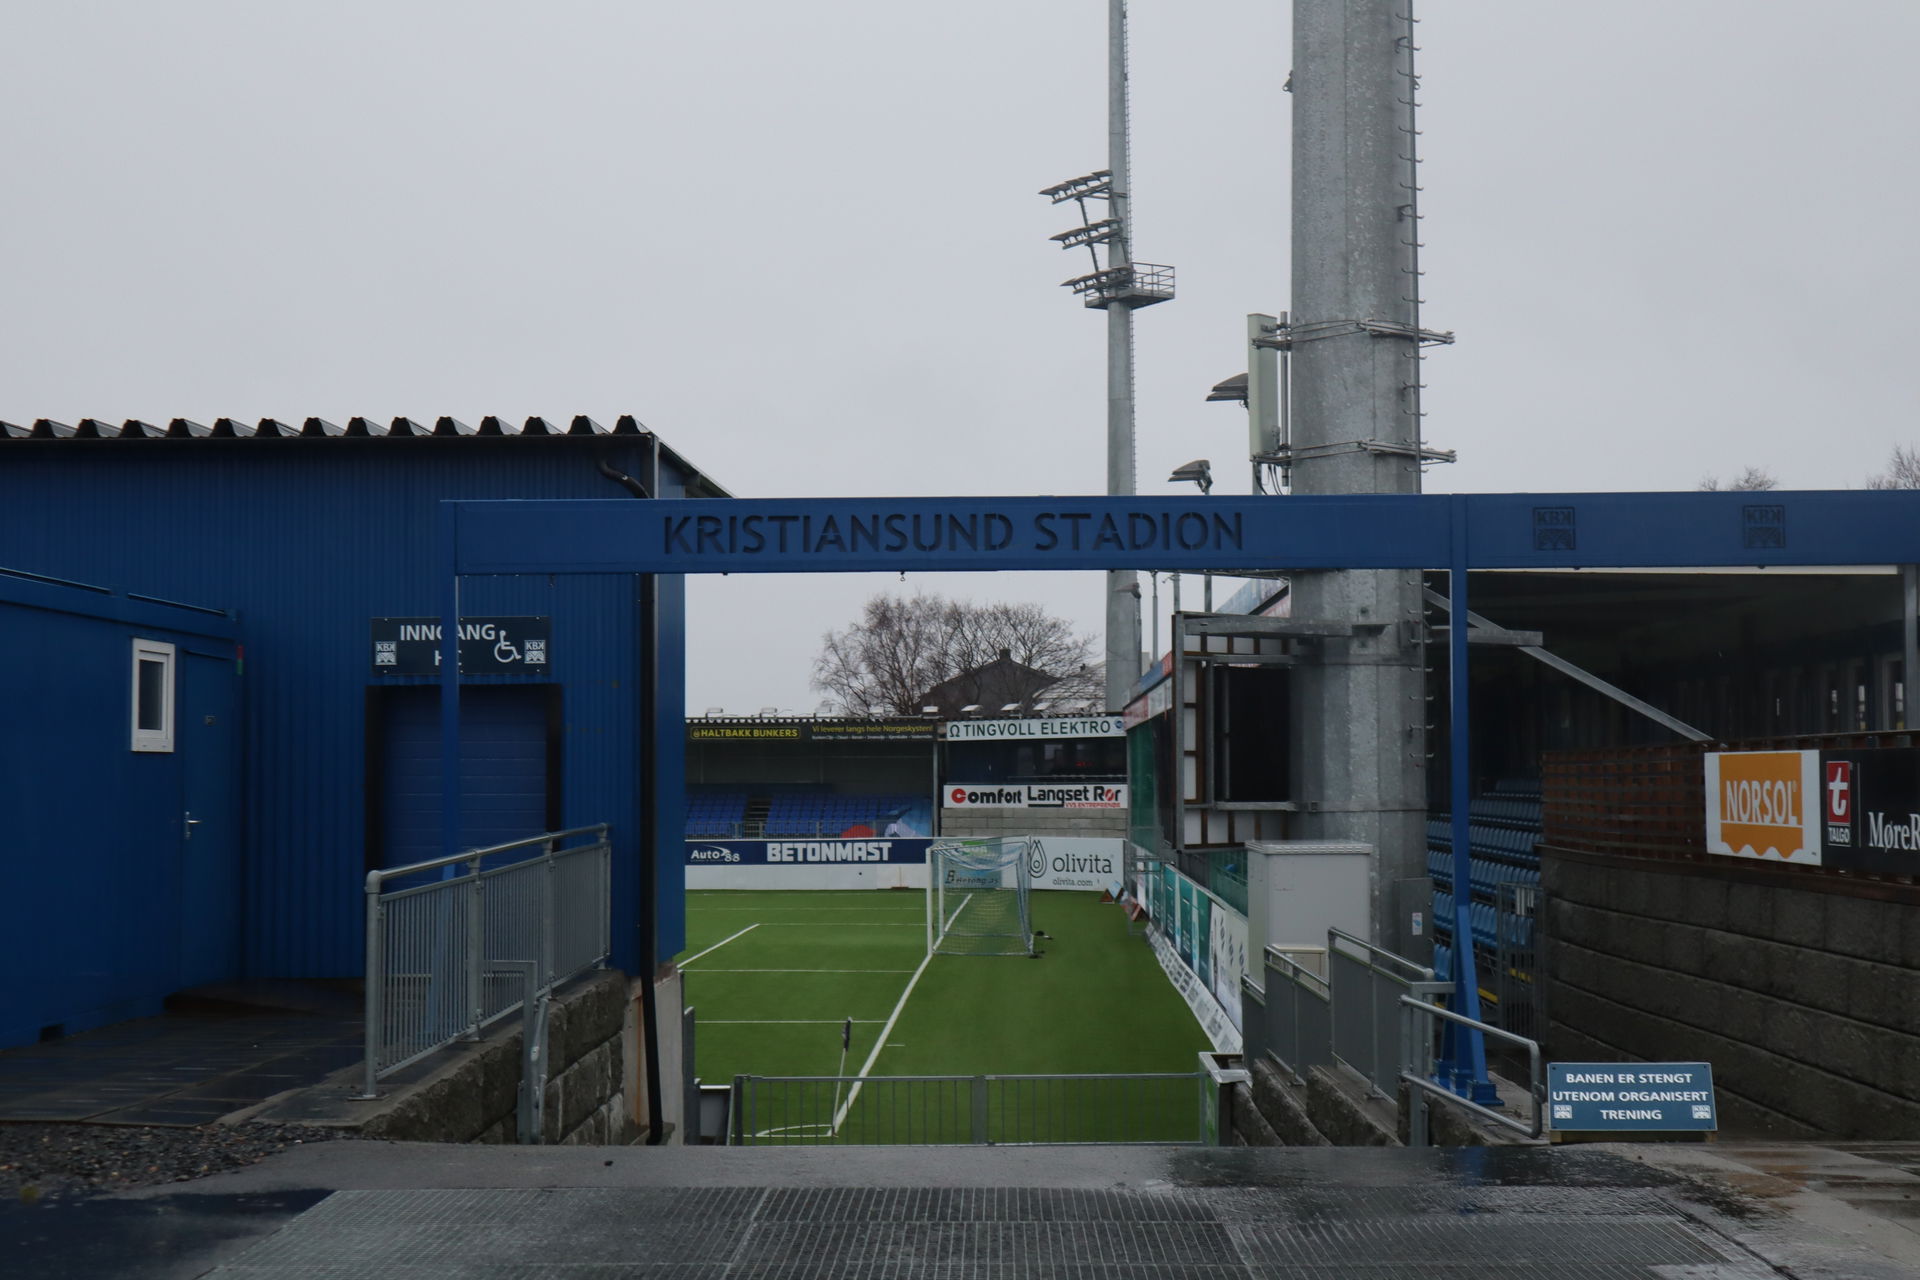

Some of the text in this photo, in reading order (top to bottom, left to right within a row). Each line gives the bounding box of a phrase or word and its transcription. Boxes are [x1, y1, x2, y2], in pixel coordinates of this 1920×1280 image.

[663, 511, 1243, 554] KRISTIANSUND STADION
[701, 728, 798, 737] HALTBAKK BUNKERS
[963, 720, 1111, 737] TINGVOLL ELEKTRO
[951, 788, 1022, 804] Comfort
[1027, 786, 1121, 805] Langset Rør
[1726, 780, 1798, 825] NORSOL
[1828, 827, 1850, 843] TALGO
[690, 849, 720, 859] Auto
[724, 853, 741, 862] 88
[767, 842, 892, 862] BETONMAST
[1053, 853, 1113, 874] olivita
[1053, 877, 1093, 886] olivita.com
[1566, 1073, 1693, 1084] BANEN ER STENGT
[1552, 1091, 1709, 1102] UTENOM ORGANISERT
[1600, 1109, 1663, 1120] TRENING
